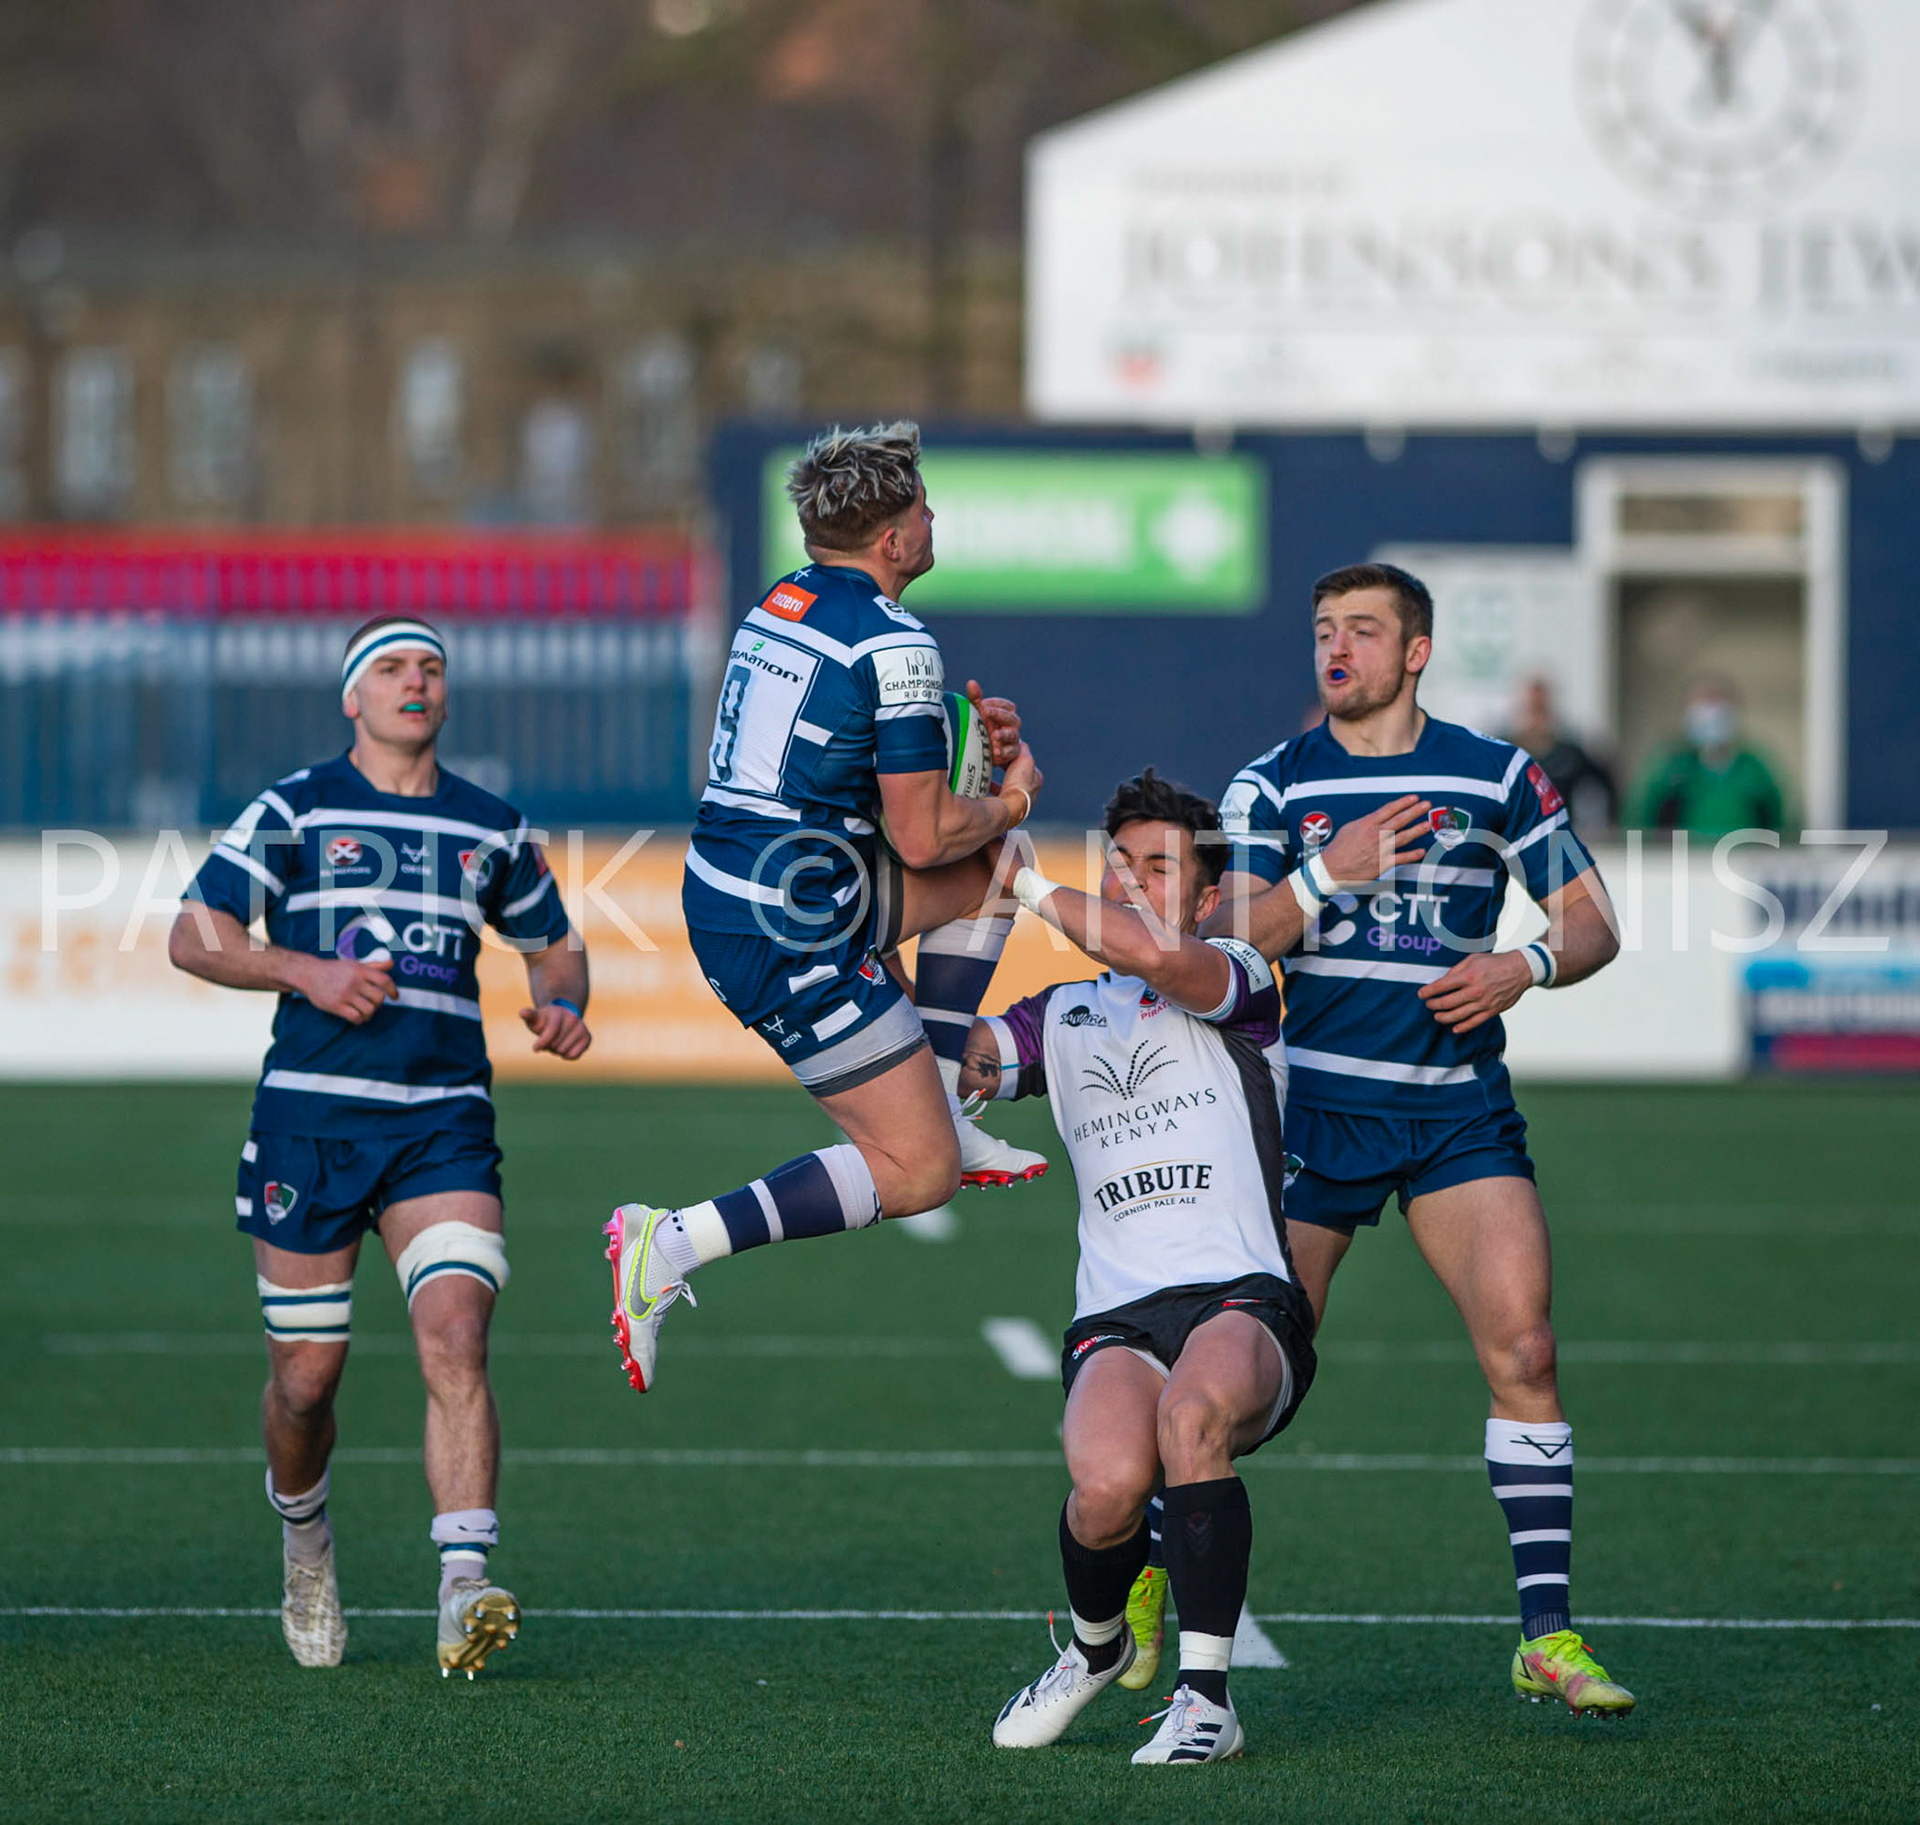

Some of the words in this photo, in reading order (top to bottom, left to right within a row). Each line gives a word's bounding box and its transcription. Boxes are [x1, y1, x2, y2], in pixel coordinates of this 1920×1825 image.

[885, 679, 943, 691] CHAMPIONS
[713, 664, 751, 782] 9
[977, 719, 990, 795] GILB
[1369, 891, 1450, 928] CTT
[402, 921, 465, 960] CTT
[1367, 926, 1442, 956] Group
[400, 955, 458, 985] Group
[1140, 999, 1172, 1021] PIRAT
[1074, 1087, 1217, 1143] HEMINGWAYS
[1100, 1118, 1178, 1149] KENYA
[1094, 1164, 1213, 1213] TRIBUTE
[1113, 1202, 1151, 1222] CORNISH
[1154, 1197, 1176, 1208] PALE
[1179, 1196, 1197, 1205] ALE
